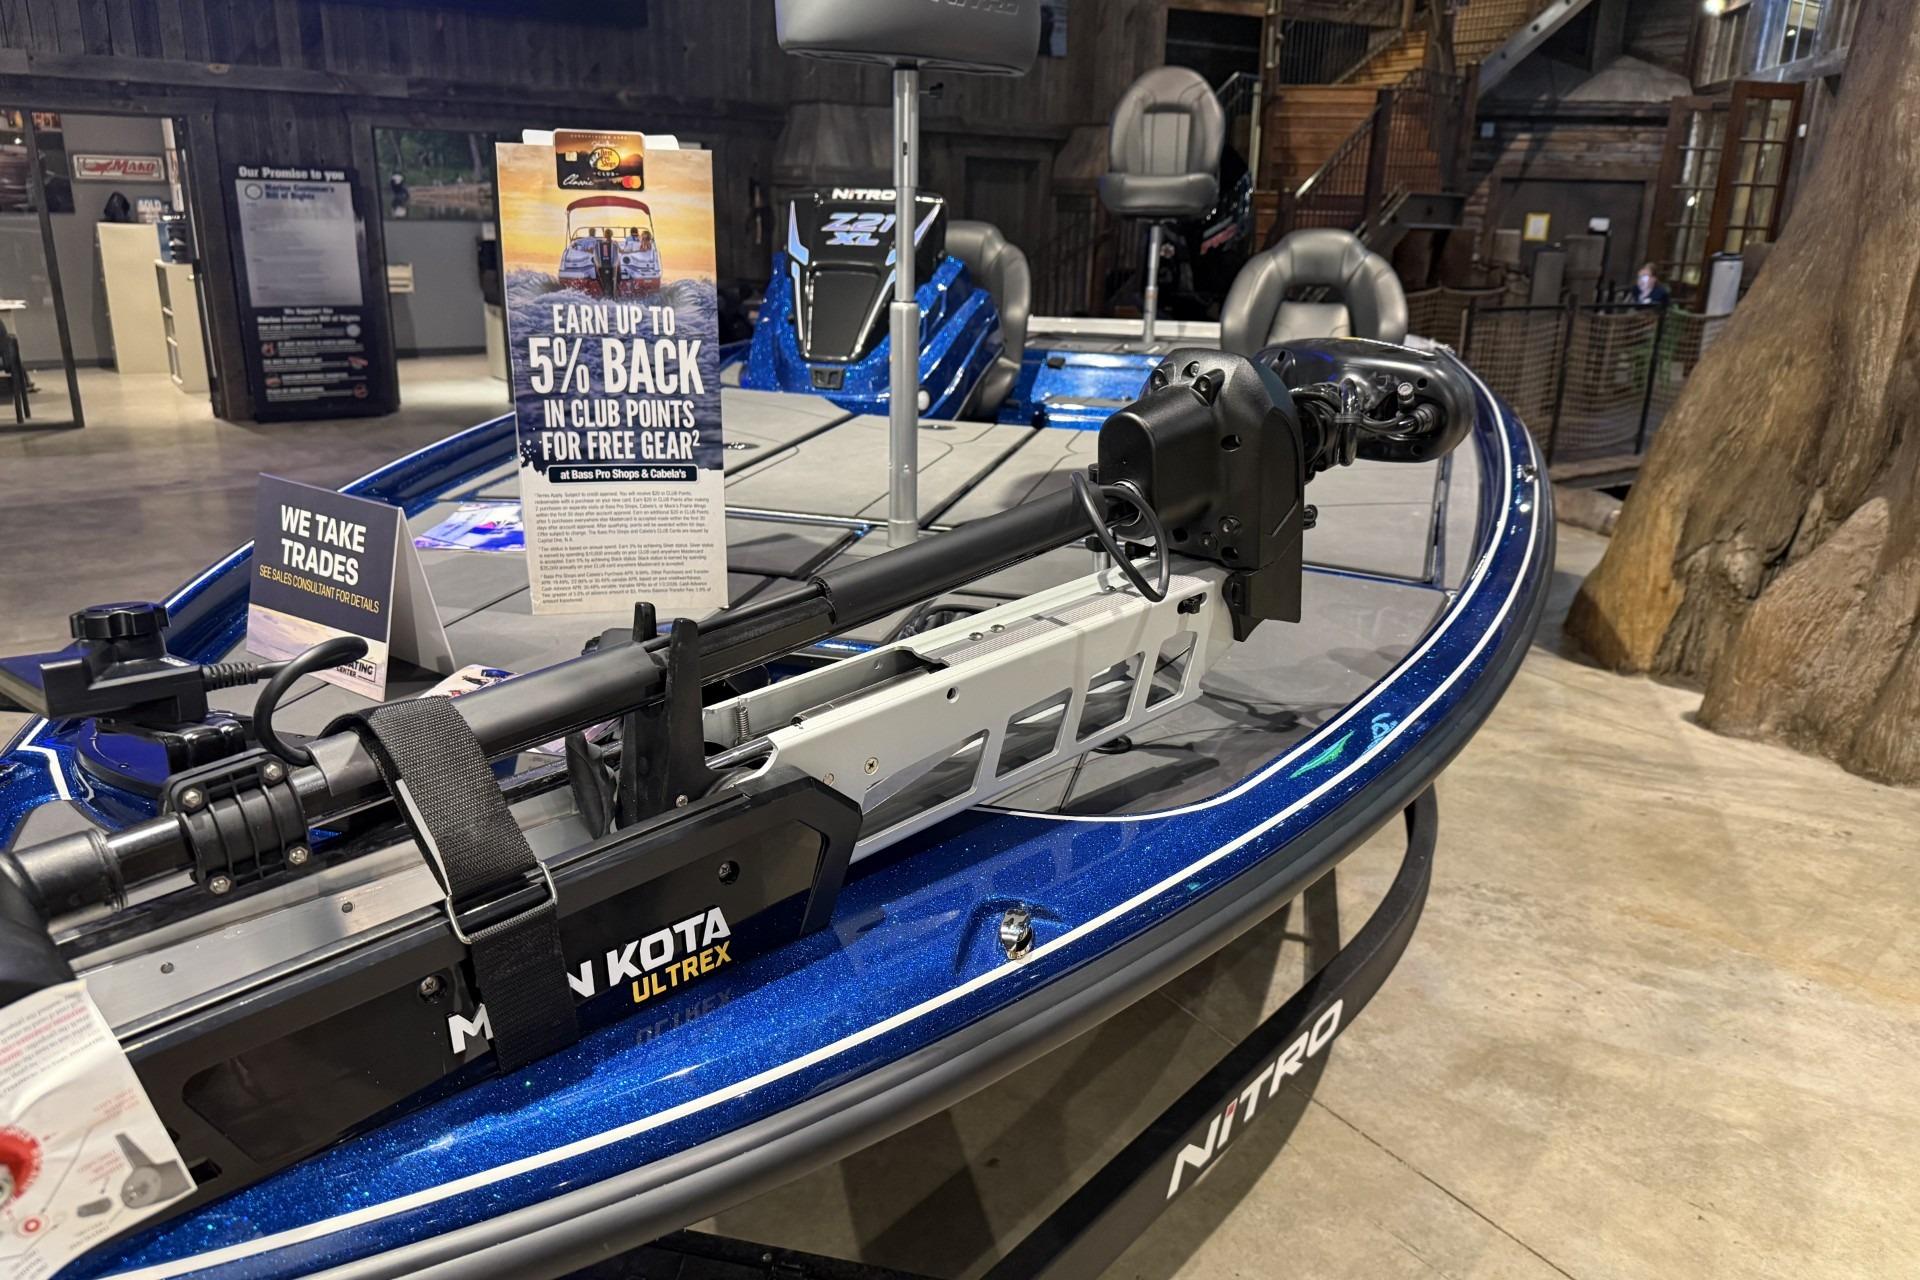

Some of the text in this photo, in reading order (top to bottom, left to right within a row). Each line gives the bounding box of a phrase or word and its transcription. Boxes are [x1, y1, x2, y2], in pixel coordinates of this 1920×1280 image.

[238, 166, 345, 182] Our Promise to you
[562, 174, 594, 186] Classic
[832, 188, 897, 200] NITRO
[826, 232, 880, 246] XL
[553, 304, 676, 336] EARN UP TO
[528, 337, 705, 395] 5% BACK
[544, 399, 696, 428] IN CLUB POINTS
[541, 431, 581, 461] FOR
[587, 431, 635, 460] FREE
[560, 468, 687, 480] at Bass Pro Shops & Cabela's
[281, 504, 367, 553] WE TAKE
[281, 538, 360, 586] TRADES
[259, 564, 380, 614] SEE SALES CONSULTANT FOR DETAILS
[448, 960, 595, 1055] MN
[606, 906, 732, 987] KOTA
[632, 940, 732, 1004] ULTREX
[1166, 999, 1344, 1200] NITRO
